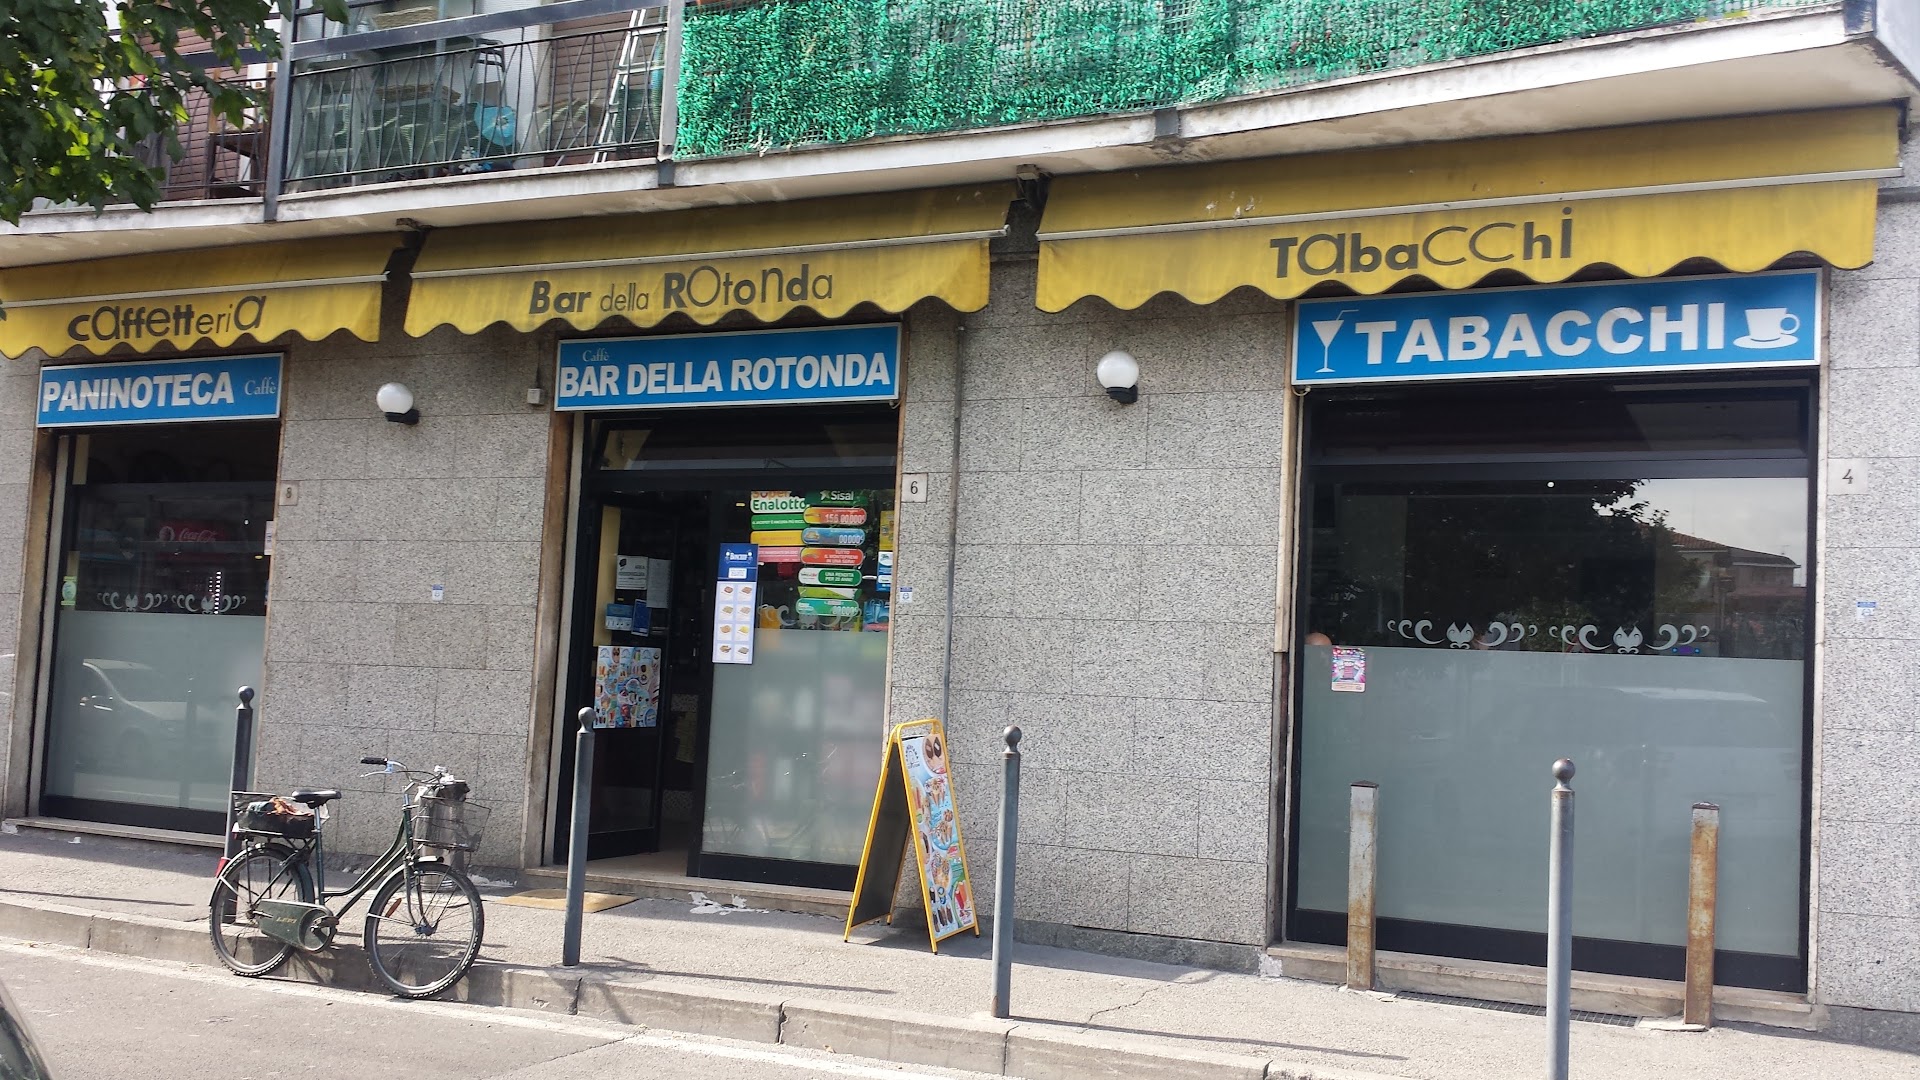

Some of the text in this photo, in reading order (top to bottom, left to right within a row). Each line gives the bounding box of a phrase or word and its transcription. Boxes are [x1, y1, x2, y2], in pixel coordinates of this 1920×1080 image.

[528, 280, 591, 314] Bar
[600, 282, 649, 312] della
[1356, 302, 1725, 365] TABACCHI
[582, 348, 610, 363] Caffè
[560, 352, 890, 398] BAR DELLA ROTONDA
[42, 371, 234, 413] PANINOTECA
[244, 376, 277, 397] Caffè
[1842, 468, 1854, 485] 4
[285, 487, 292, 499] 8
[831, 490, 854, 501] Sisal
[910, 481, 919, 495] 6
[752, 498, 806, 511] Enalotto
